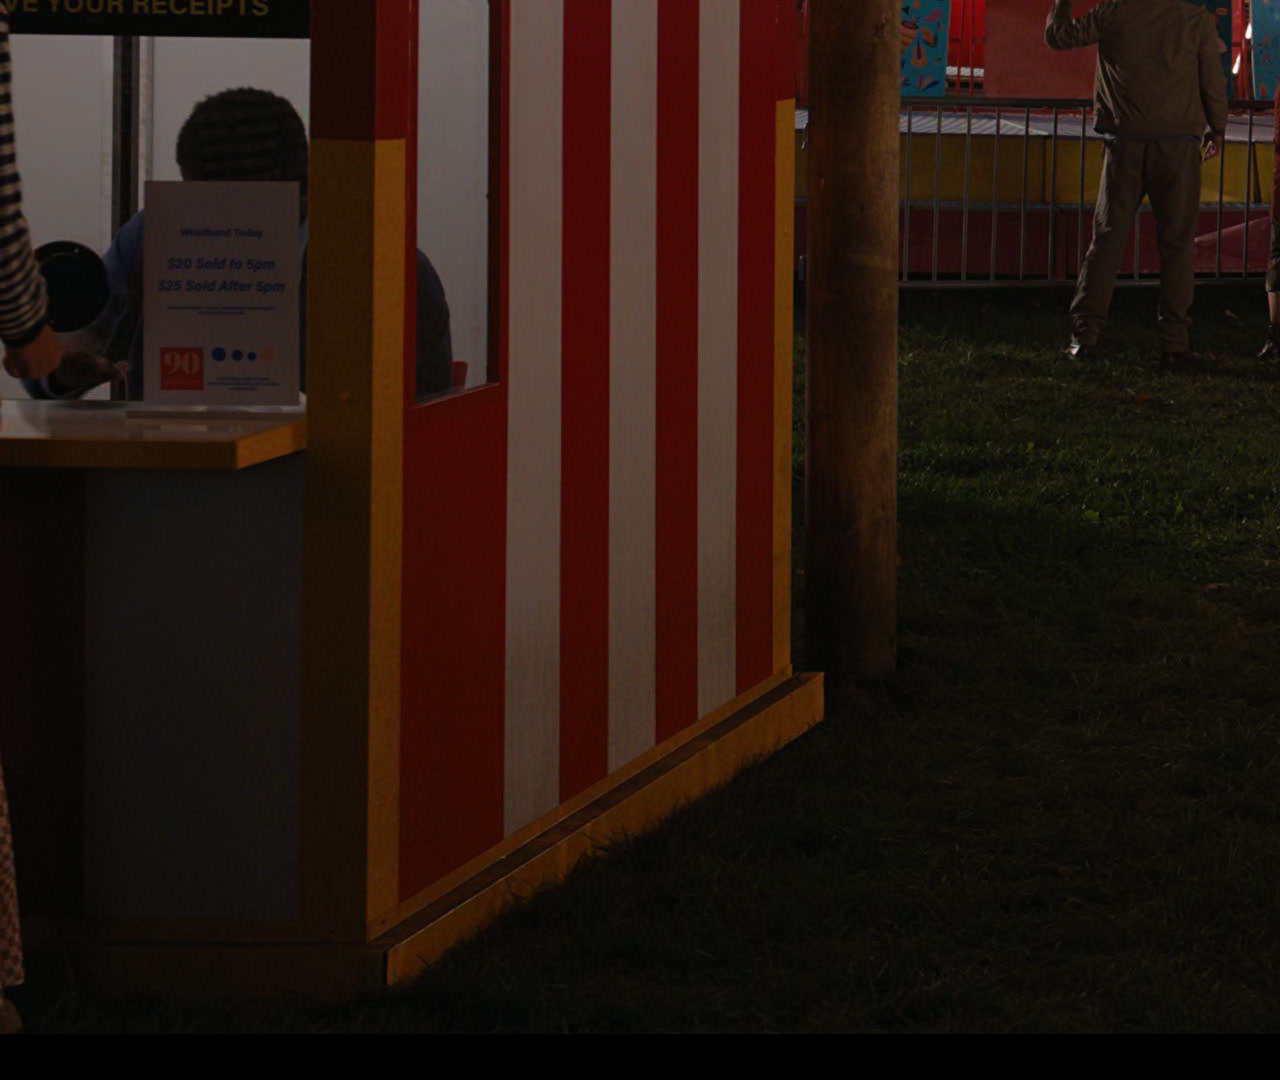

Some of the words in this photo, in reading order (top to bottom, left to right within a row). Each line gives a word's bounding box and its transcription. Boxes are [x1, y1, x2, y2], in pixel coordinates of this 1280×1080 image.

[167, 257, 192, 270] $20
[195, 257, 226, 270] Sold
[230, 258, 242, 270] to
[157, 279, 182, 292] $25
[185, 279, 216, 292] Sold
[219, 279, 252, 292] After
[255, 280, 285, 294] 5pm
[163, 351, 200, 376] 90
